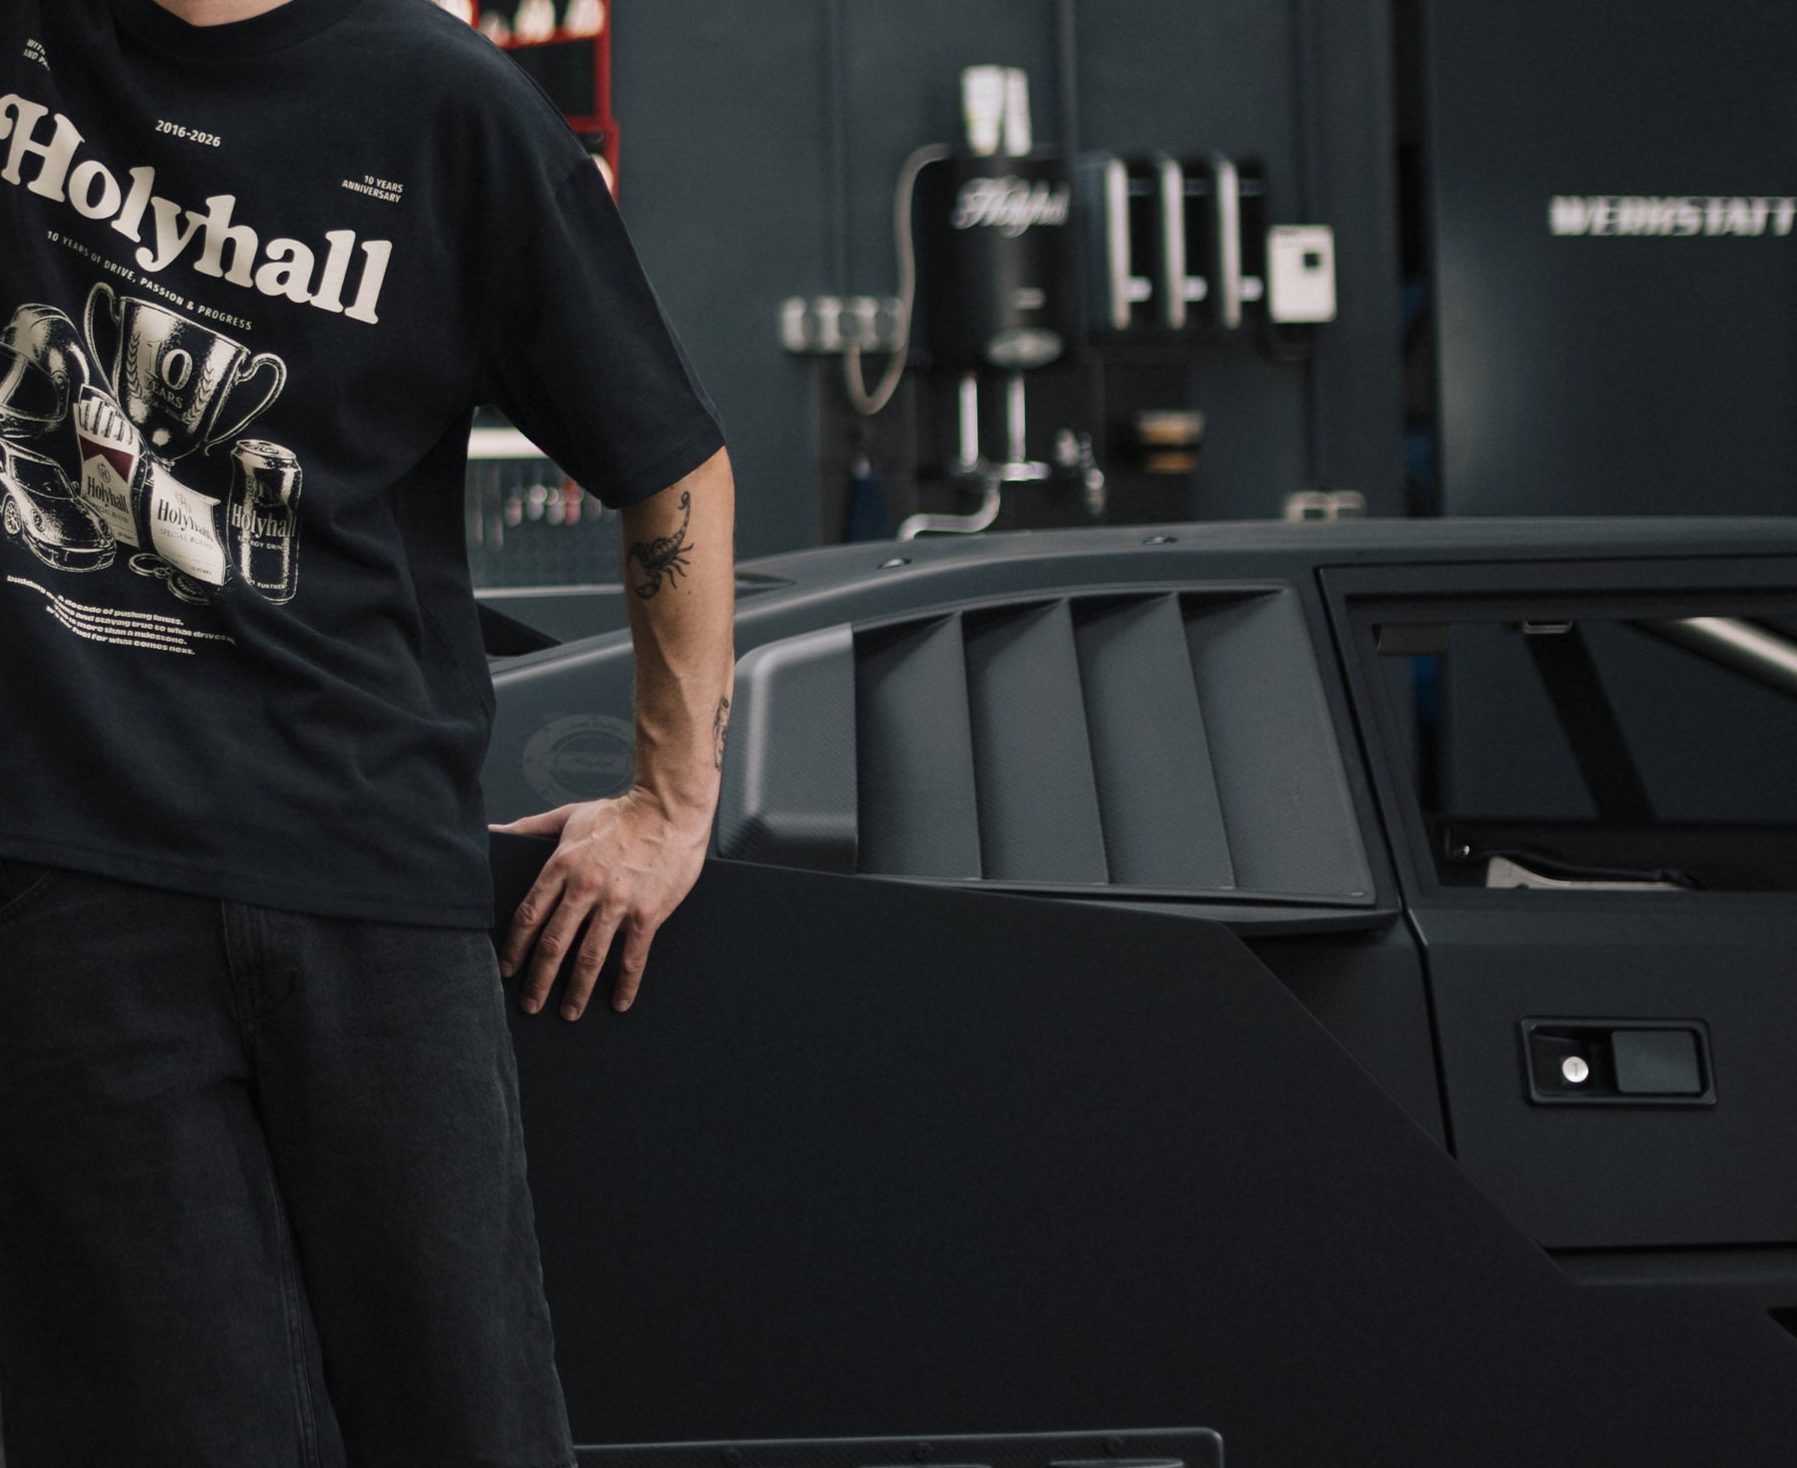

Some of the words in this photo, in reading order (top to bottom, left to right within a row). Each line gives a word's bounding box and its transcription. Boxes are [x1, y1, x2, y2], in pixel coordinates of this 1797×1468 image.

[155, 119, 221, 147] 2016-2026
[342, 179, 401, 203] ANNIVERSARY
[364, 175, 375, 185] 10
[376, 178, 403, 193] YEARS
[46, 230, 59, 243] 10
[62, 236, 89, 258] YEARS
[90, 252, 103, 264] OF
[103, 259, 137, 283] DRIVE,
[140, 277, 184, 306] PASSION
[186, 301, 194, 310] &
[197, 304, 253, 331] PROGRESS
[146, 339, 193, 390] 10
[87, 475, 129, 514] Holyhall
[231, 503, 297, 538] Holyhall
[7, 575, 46, 594] building
[75, 612, 95, 622] and
[95, 616, 131, 627] staying
[132, 620, 153, 630] true
[154, 624, 166, 632] to
[167, 626, 192, 637] what
[193, 631, 226, 641] drives
[64, 599, 102, 614] decade
[113, 610, 153, 621] pushing
[72, 626, 91, 639] fuel
[91, 633, 108, 642] for
[108, 637, 133, 646] what
[133, 640, 168, 651] comes
[168, 645, 196, 656] next.
[76, 620, 104, 632] more
[104, 627, 126, 636] than
[134, 630, 188, 645] milestone.
